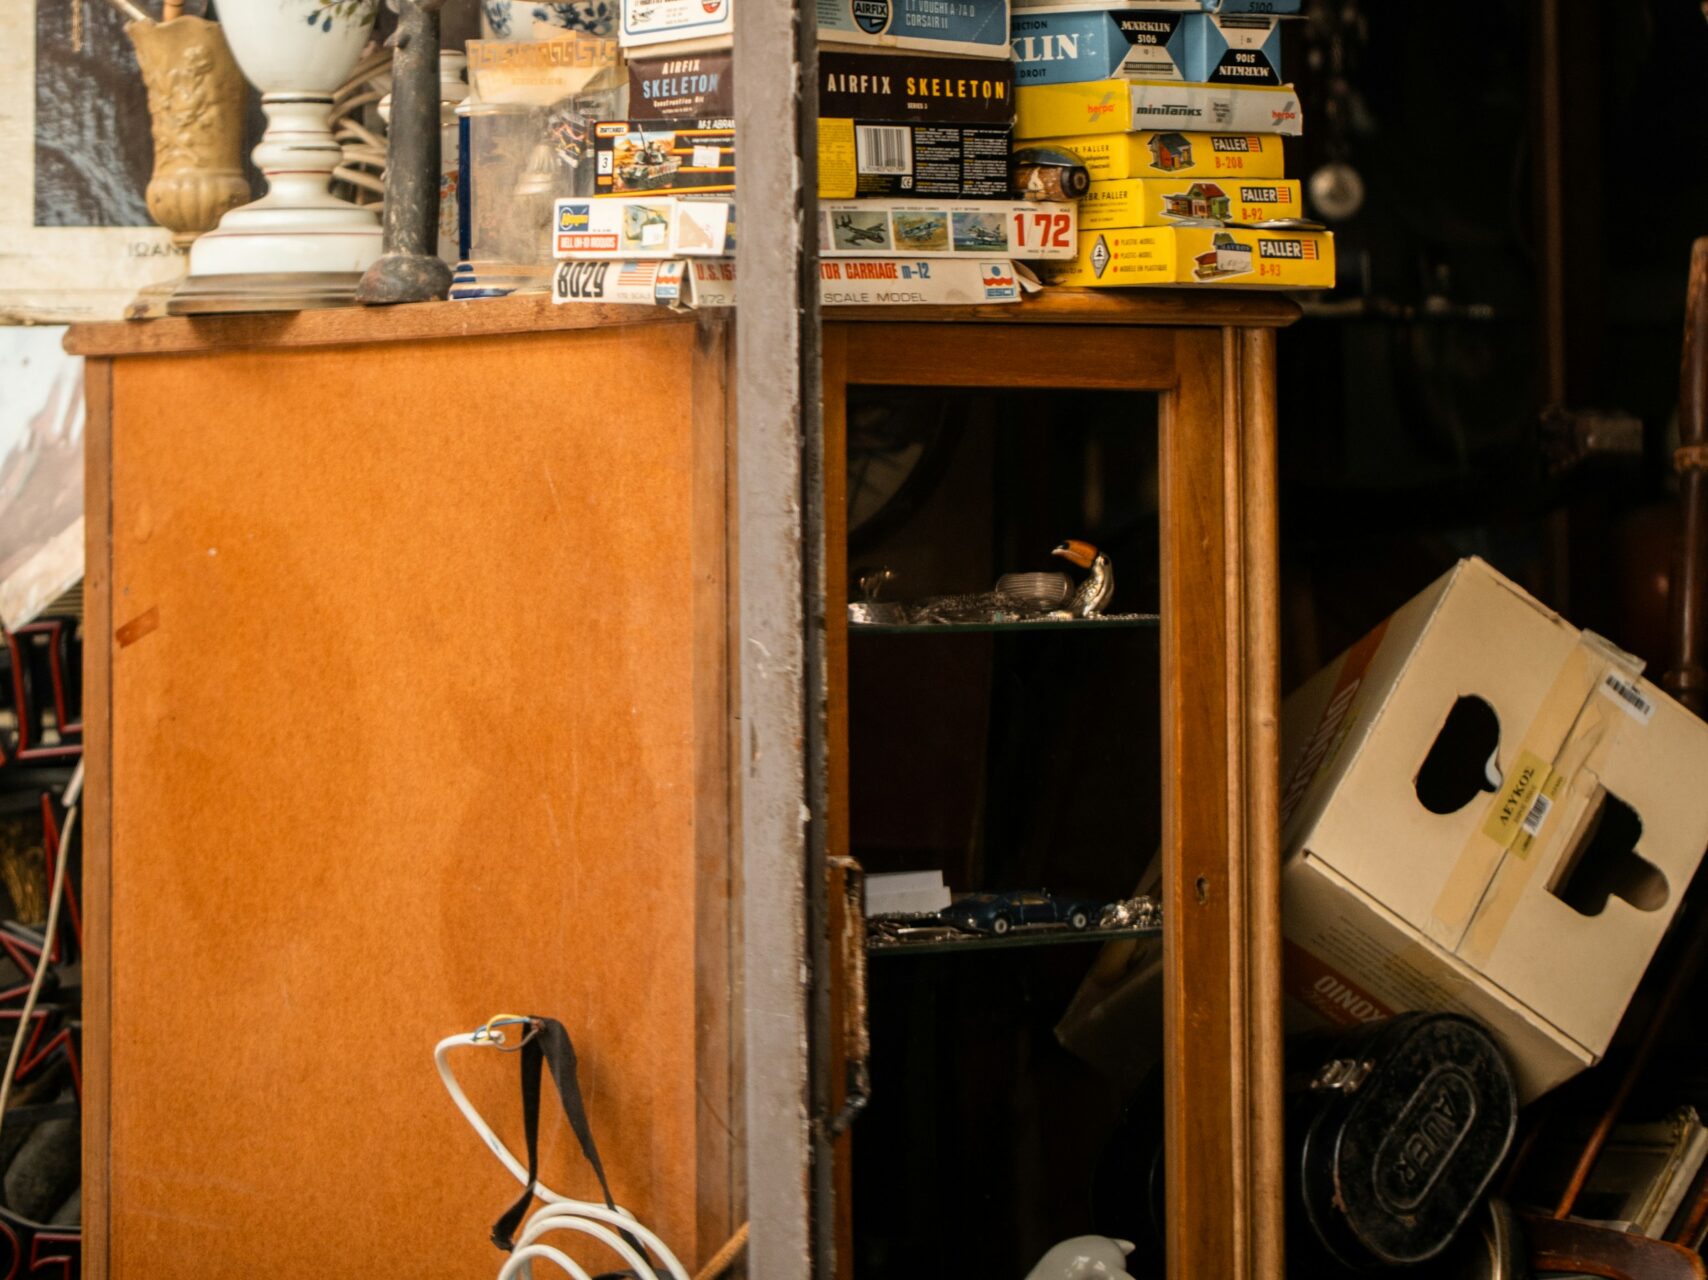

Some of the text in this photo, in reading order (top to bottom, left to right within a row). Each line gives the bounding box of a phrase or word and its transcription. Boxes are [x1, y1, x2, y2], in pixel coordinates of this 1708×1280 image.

[855, 2, 887, 16] AIRFIX
[1137, 34, 1157, 44] 5106
[661, 59, 700, 75] AIRFIX
[1020, 68, 1046, 78] DROIT
[642, 73, 718, 99] SKELETON
[827, 73, 1004, 99] AIRFIX SKELETON
[1213, 138, 1248, 151] FALLER
[602, 157, 609, 169] 3
[1102, 190, 1128, 199] FALLER
[1241, 188, 1277, 202] FALLER
[1242, 208, 1263, 220] B-92
[1260, 241, 1302, 257] FALLER
[845, 262, 898, 280] CARRIAGE
[901, 262, 931, 280] m-12
[1260, 264, 1281, 276] B-93
[558, 262, 610, 298] 8029
[824, 292, 928, 303] SCALE MODEL
